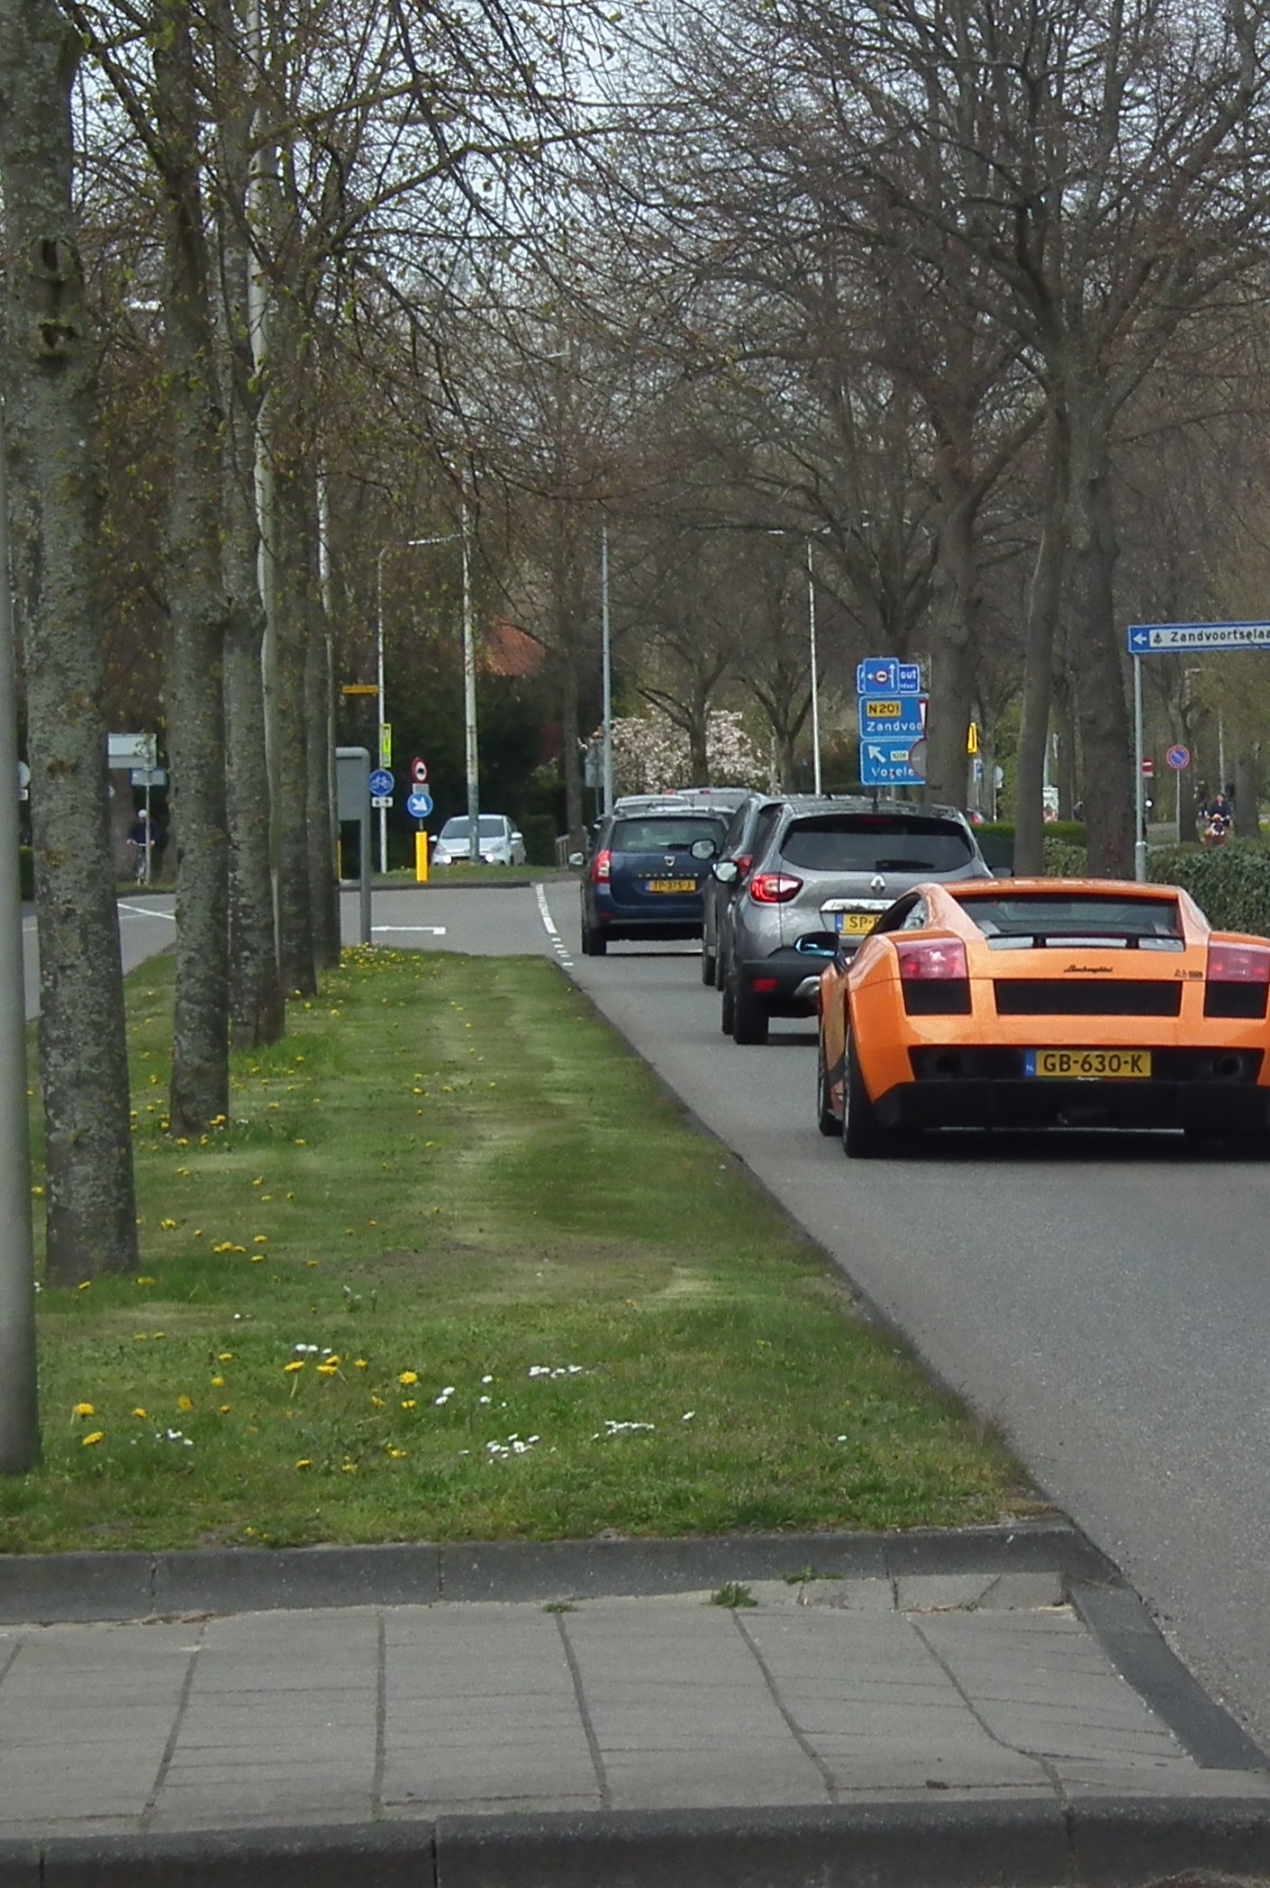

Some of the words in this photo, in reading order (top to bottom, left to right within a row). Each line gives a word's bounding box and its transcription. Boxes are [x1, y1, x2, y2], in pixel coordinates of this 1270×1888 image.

[868, 703, 899, 715] N201
[866, 720, 923, 732] Zandvoo
[1043, 1053, 1143, 1074] GB-630-K
